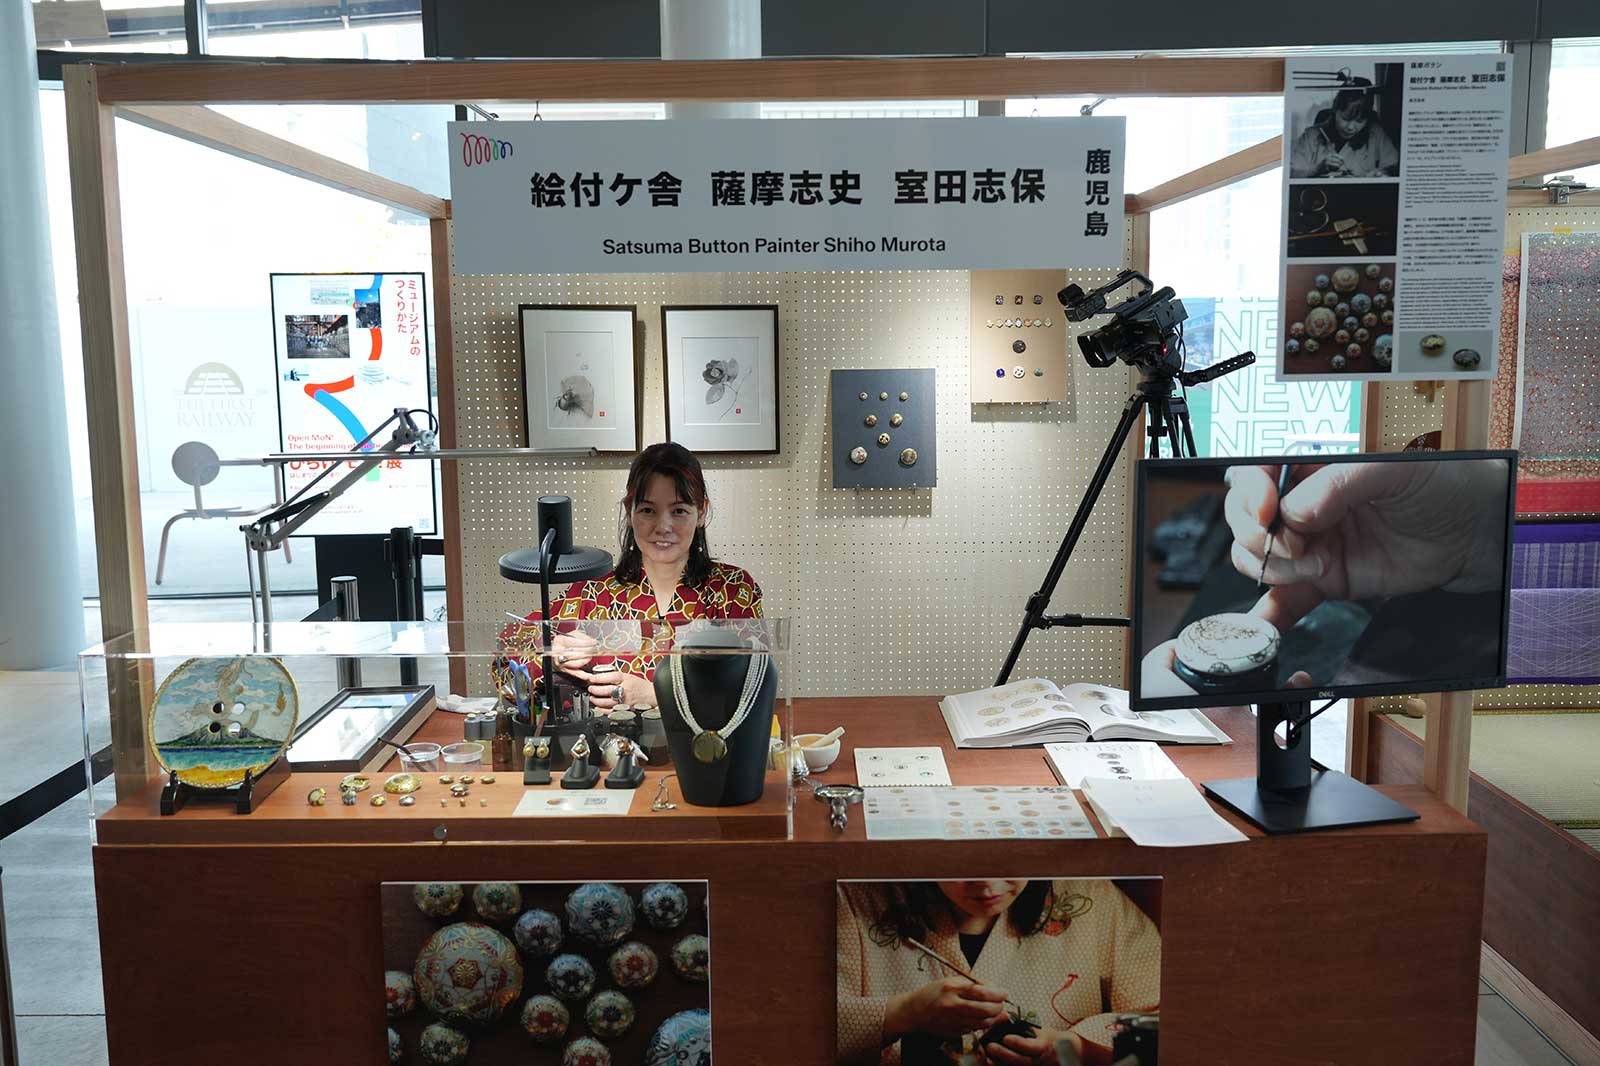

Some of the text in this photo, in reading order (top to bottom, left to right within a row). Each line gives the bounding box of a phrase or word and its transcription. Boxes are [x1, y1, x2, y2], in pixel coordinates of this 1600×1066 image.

[531, 168, 1045, 208] 絵付ケ舎 薩摩志史 室田志保
[1085, 149, 1111, 237] 鹿児島
[603, 236, 946, 254] Satsuma Button Painter Shiho Murota
[395, 279, 408, 334] つくりかた
[408, 279, 421, 356] ミュージアムの
[176, 411, 256, 427] RAILWAY
[288, 434, 310, 442] Open
[1319, 690, 1335, 698] DELL
